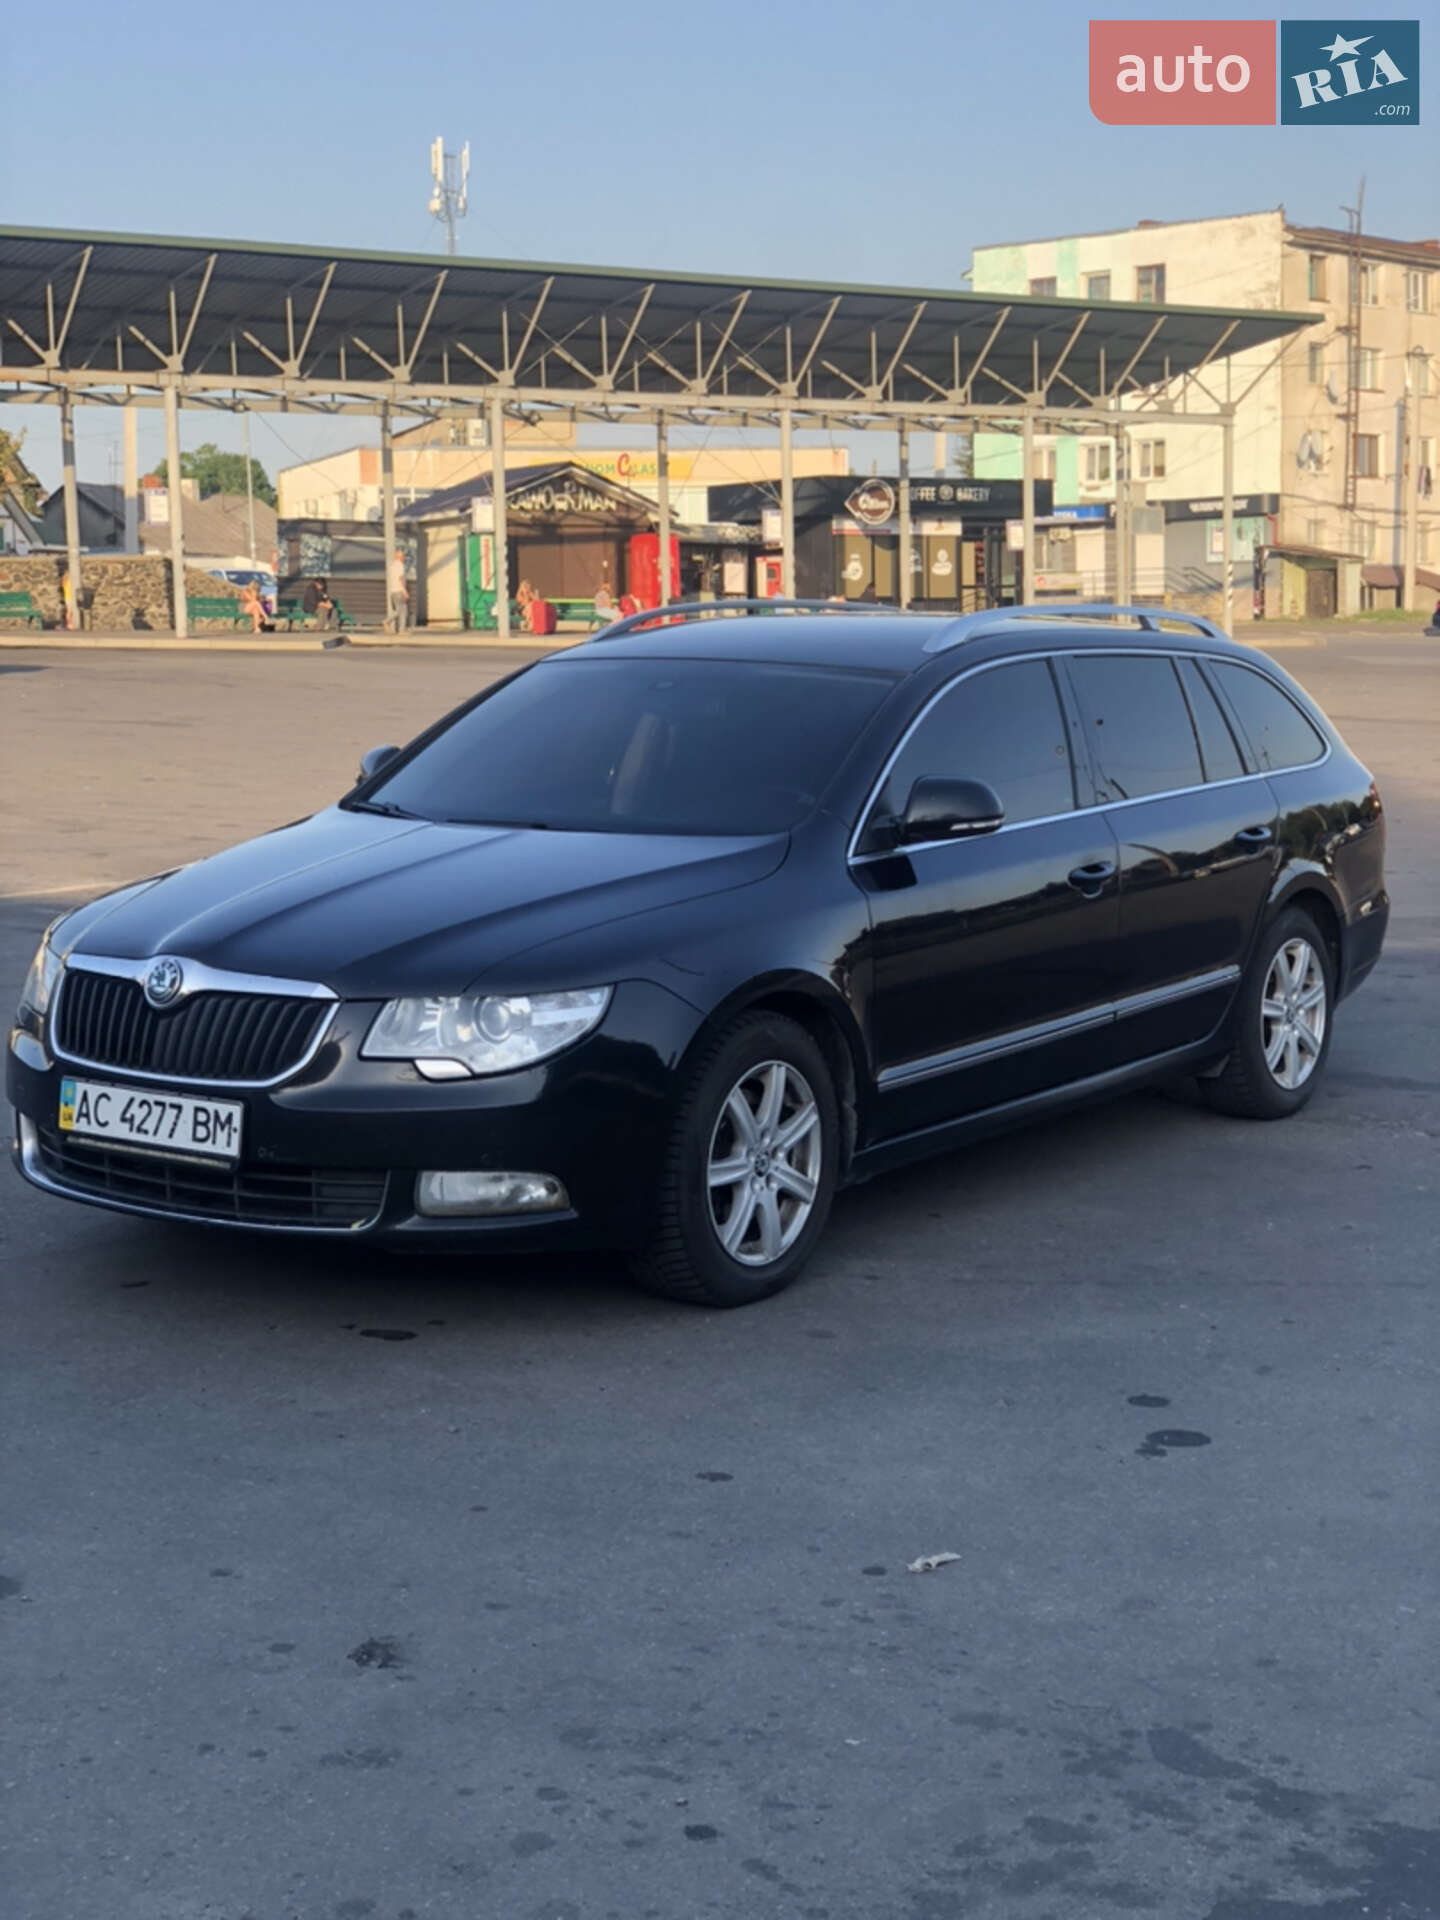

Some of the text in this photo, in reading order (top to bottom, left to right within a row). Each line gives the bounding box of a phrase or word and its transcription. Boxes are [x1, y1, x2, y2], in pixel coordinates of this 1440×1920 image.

[76, 1089, 234, 1148] AC 4277 BM
